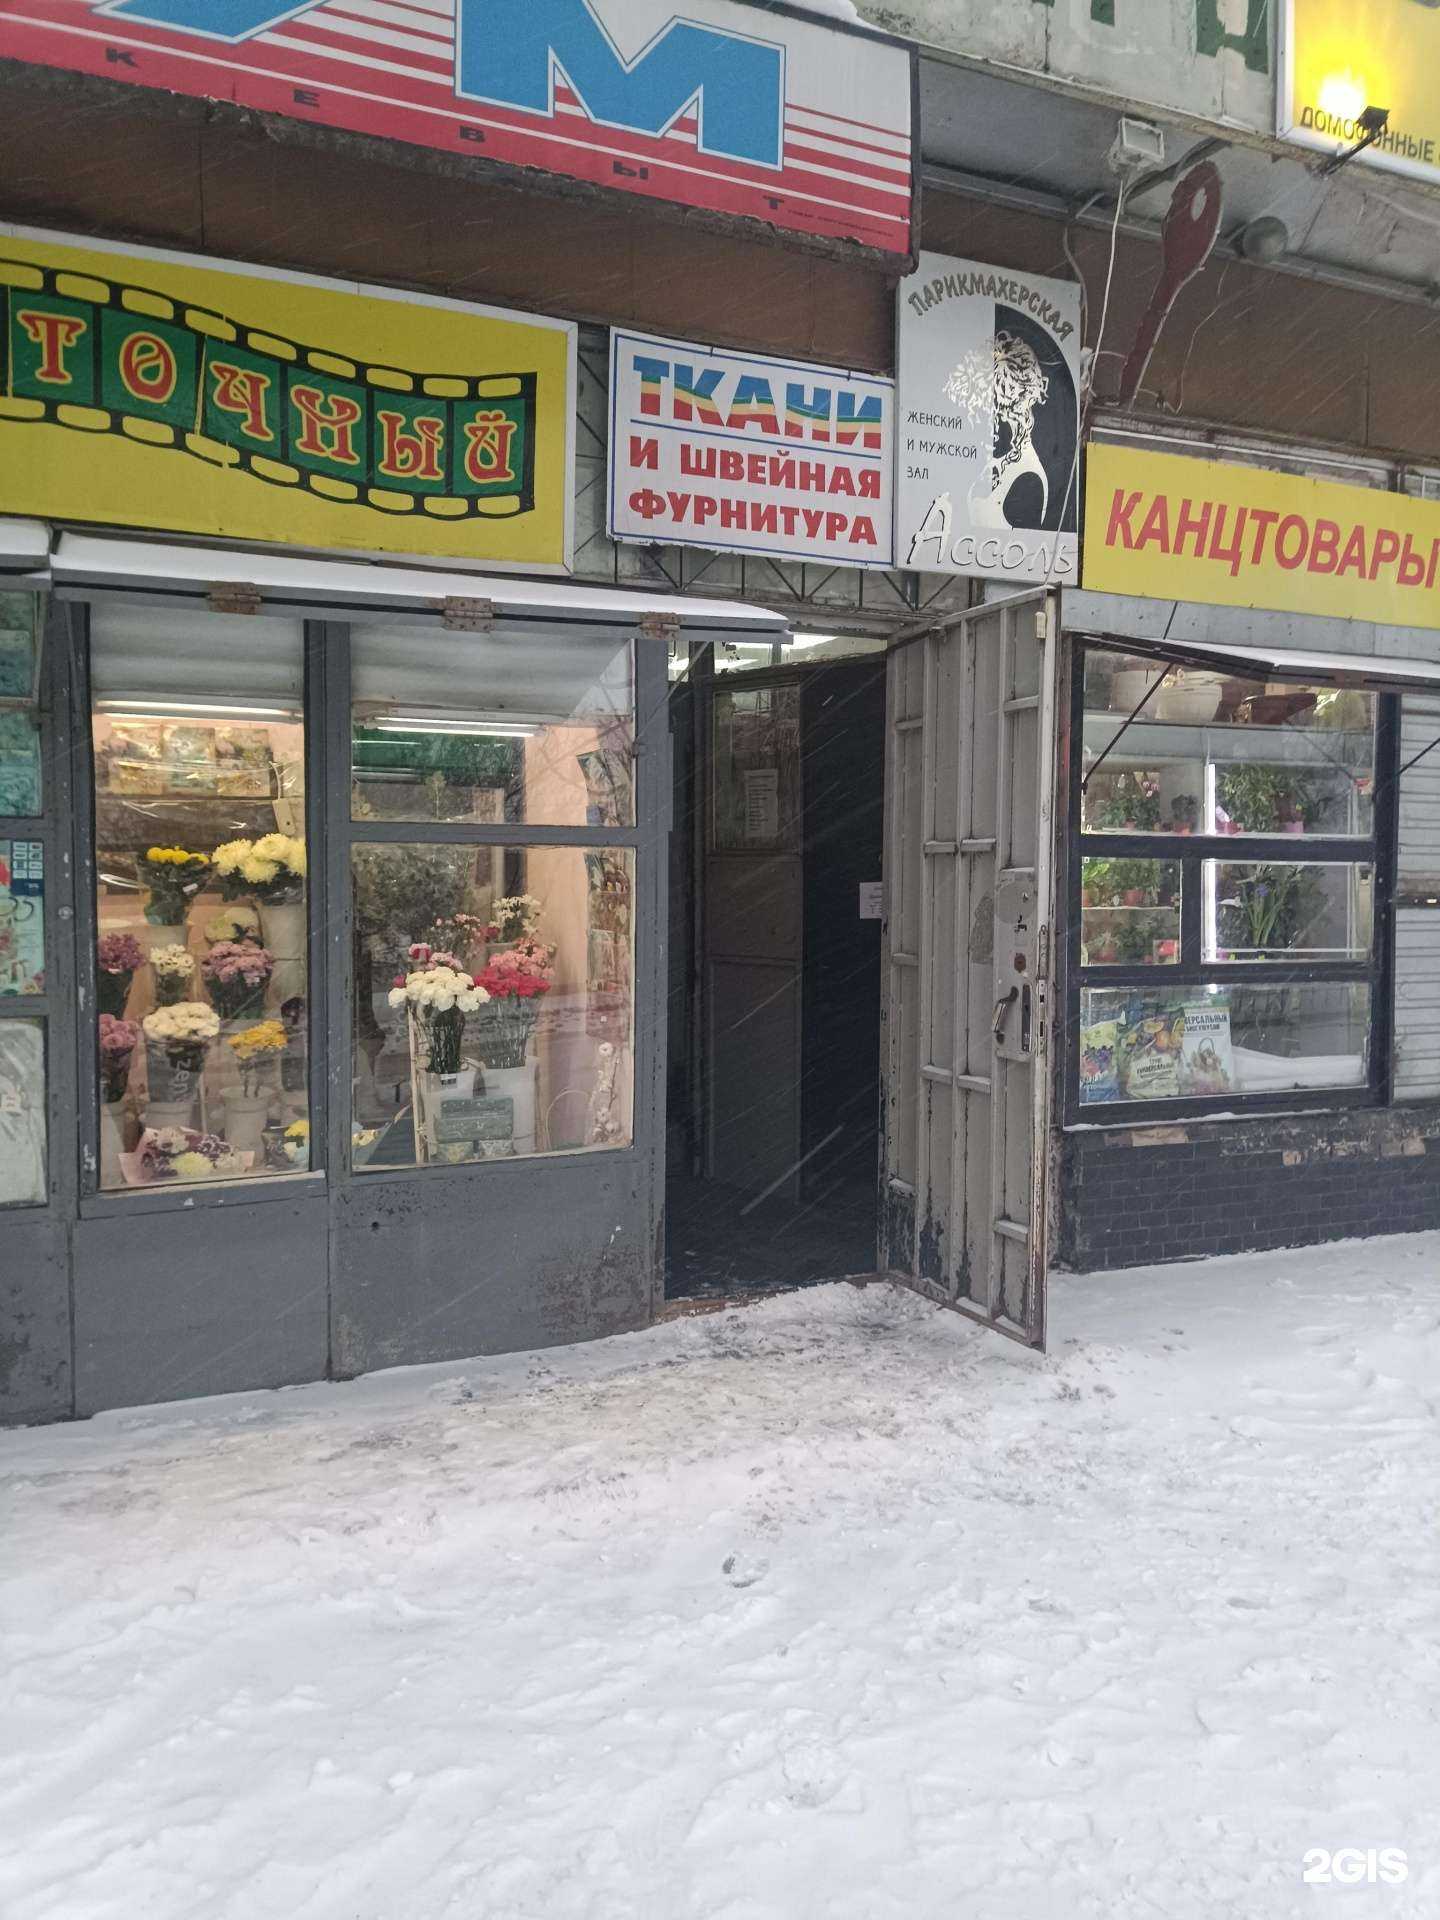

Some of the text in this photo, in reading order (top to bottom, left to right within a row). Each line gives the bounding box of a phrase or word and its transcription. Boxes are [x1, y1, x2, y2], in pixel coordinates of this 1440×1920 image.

[908, 272, 1074, 342] ПАРИКМАХЕРСКАЯ
[16, 309, 518, 485] ТОЧНЫЙ
[633, 355, 881, 449] ТКАНИ
[907, 411, 963, 430] ЖЕНСКИЙ
[630, 435, 881, 499] И ШВЕЙНАЯ
[906, 466, 929, 480] ЗАЛ
[907, 439, 977, 459] И МУЖСКОЙ
[629, 488, 878, 545] ФУРНИТУРА
[1105, 488, 1440, 589] КАНЦТОВАРЫ
